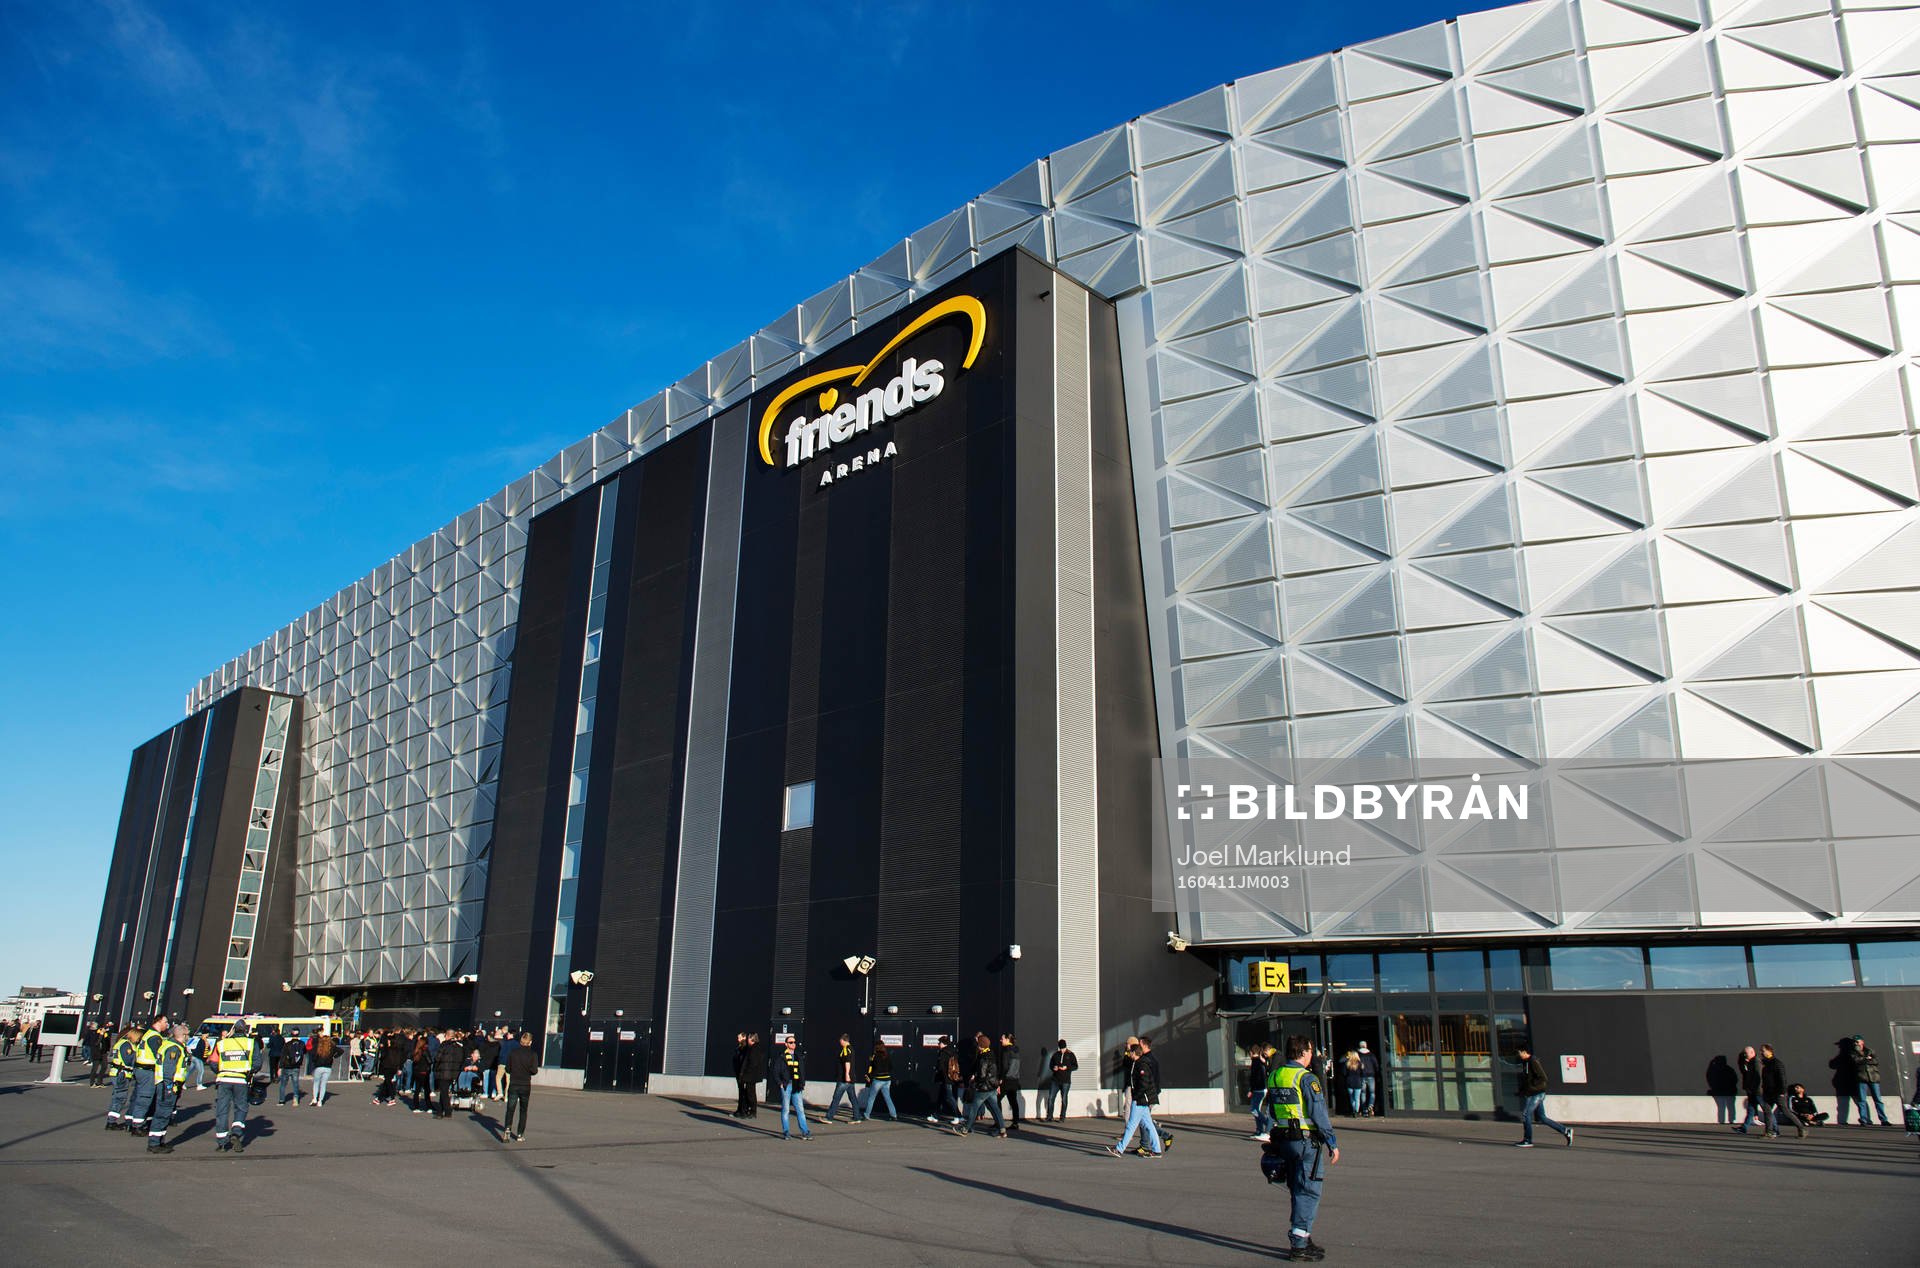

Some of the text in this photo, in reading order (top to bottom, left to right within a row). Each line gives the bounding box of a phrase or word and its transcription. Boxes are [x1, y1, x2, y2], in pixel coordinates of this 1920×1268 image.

[785, 357, 945, 467] friends
[819, 441, 898, 486] ARENA
[1264, 967, 1285, 988] Ex
